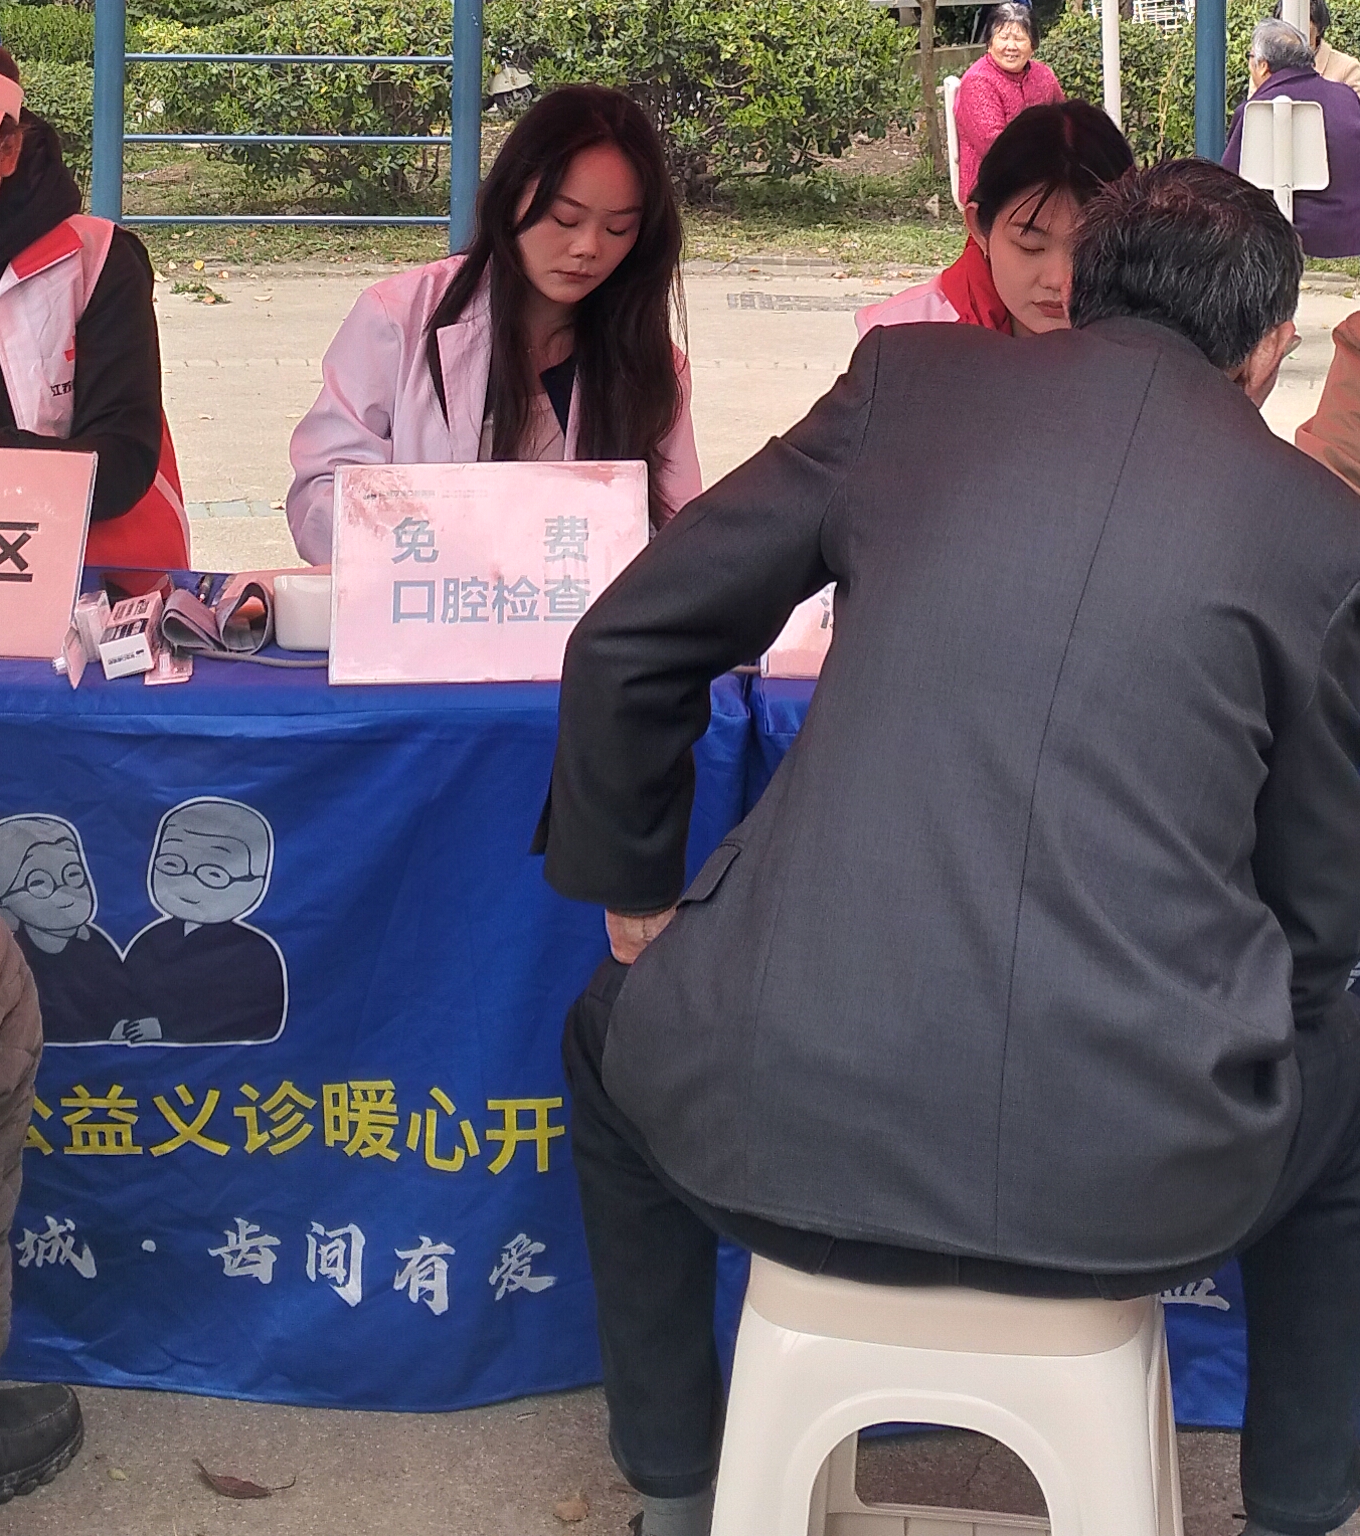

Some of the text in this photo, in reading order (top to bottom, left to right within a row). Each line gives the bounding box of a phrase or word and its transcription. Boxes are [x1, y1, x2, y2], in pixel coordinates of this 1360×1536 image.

[390, 515, 589, 564] 免 费
[391, 575, 591, 624] 口腔检查
